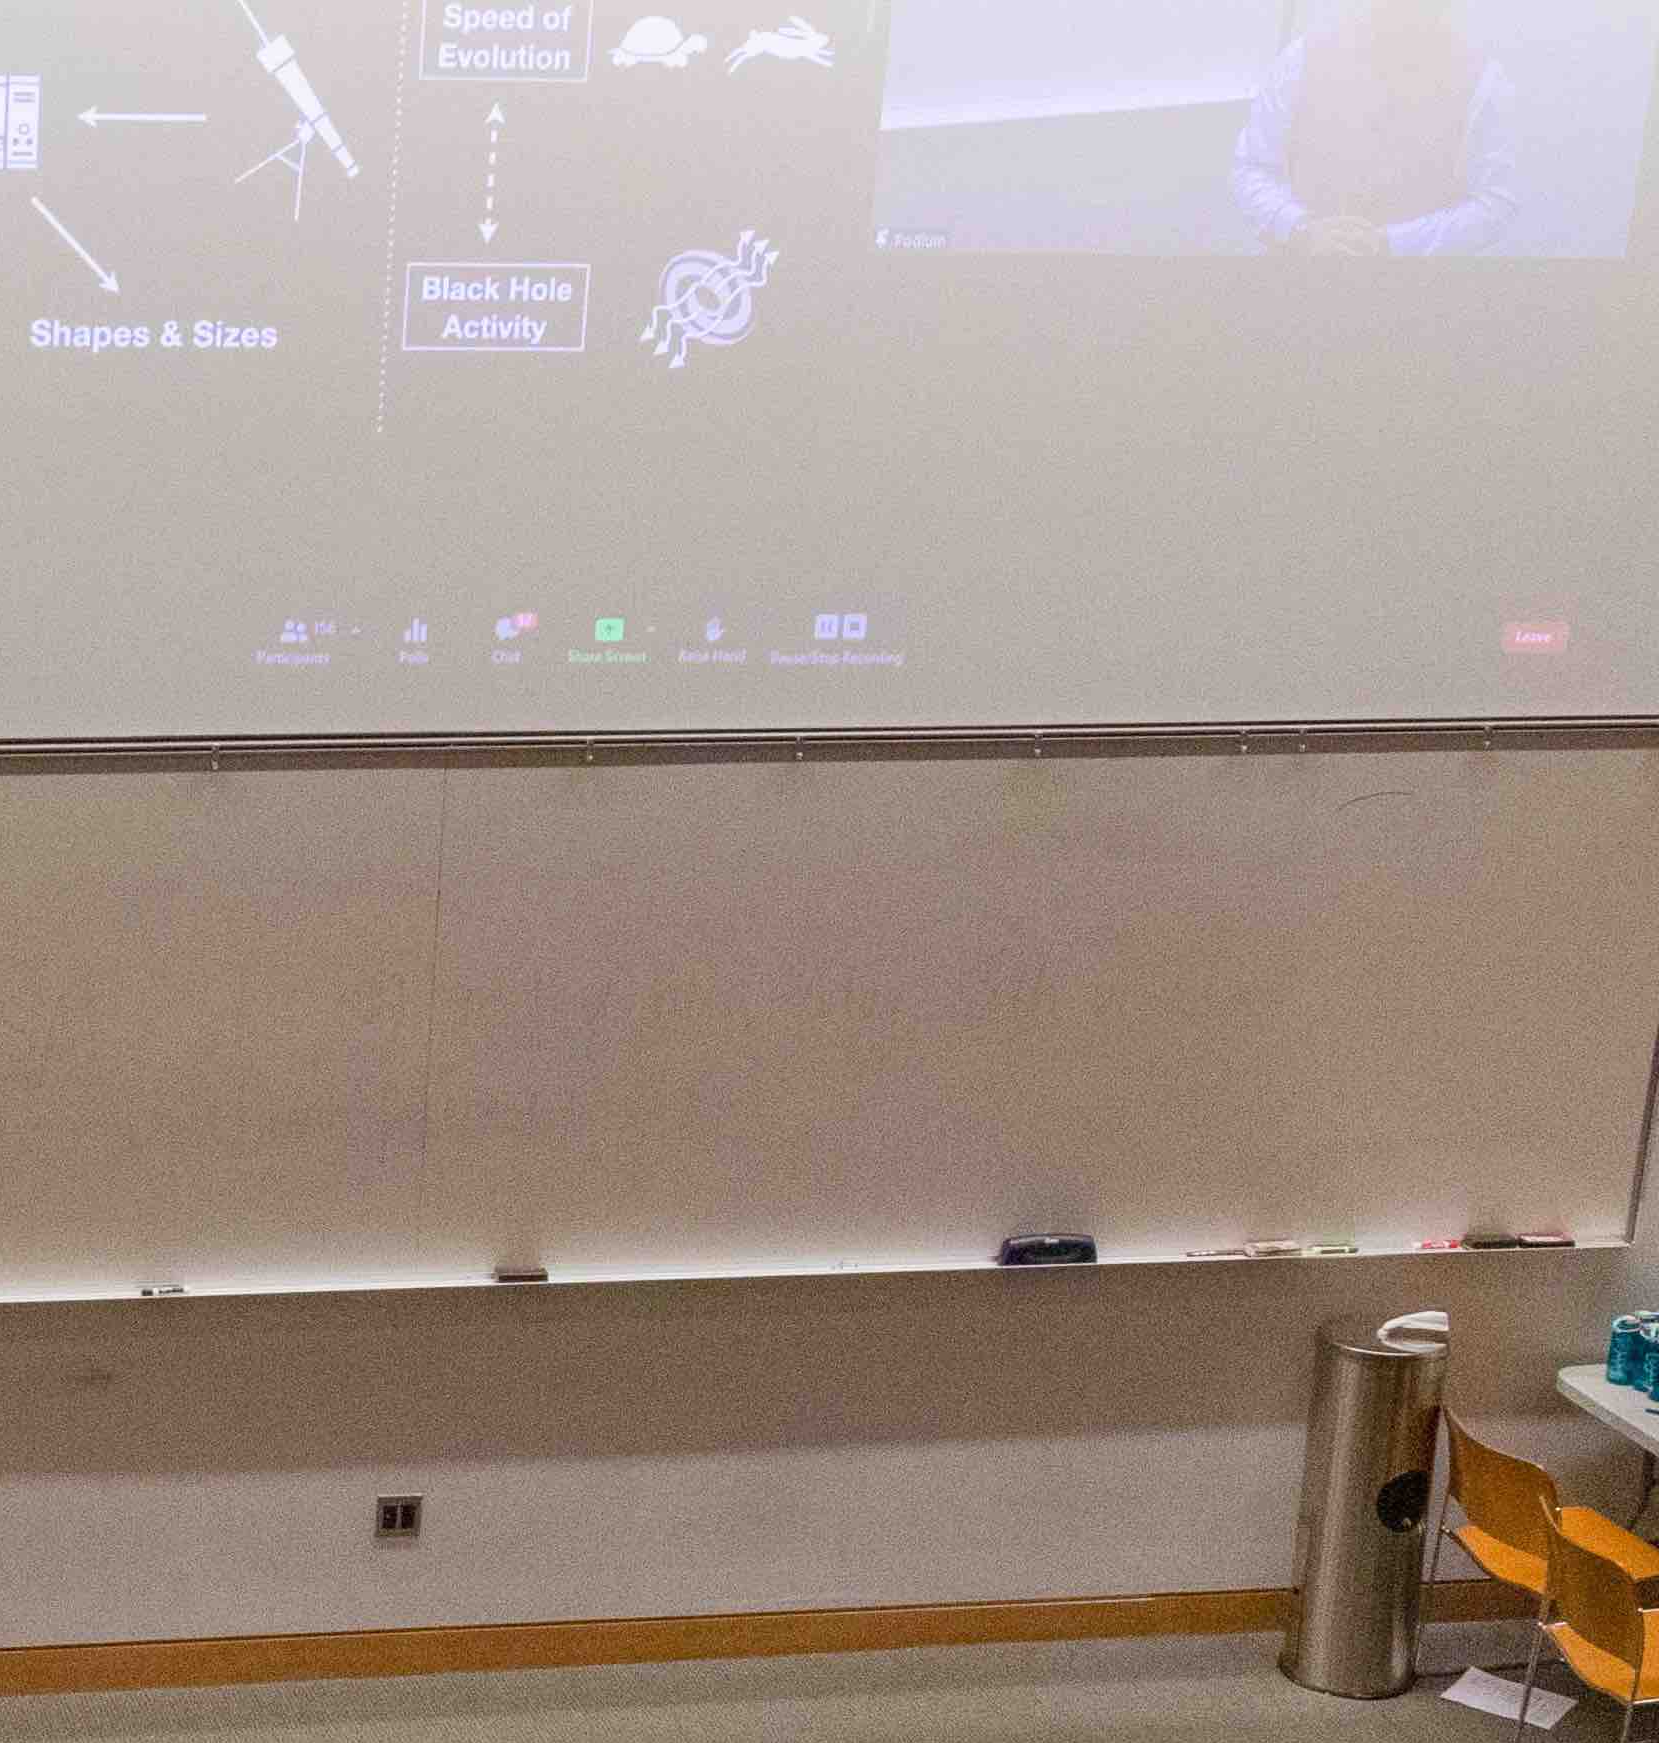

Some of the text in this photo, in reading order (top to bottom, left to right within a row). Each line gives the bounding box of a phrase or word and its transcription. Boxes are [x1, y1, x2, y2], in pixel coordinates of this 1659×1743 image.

[443, 4, 572, 35] Speed of
[438, 44, 572, 72] Evolution
[421, 276, 573, 303] Black Hole
[29, 318, 278, 353] Shapes & Sizes
[441, 314, 548, 345] Activity
